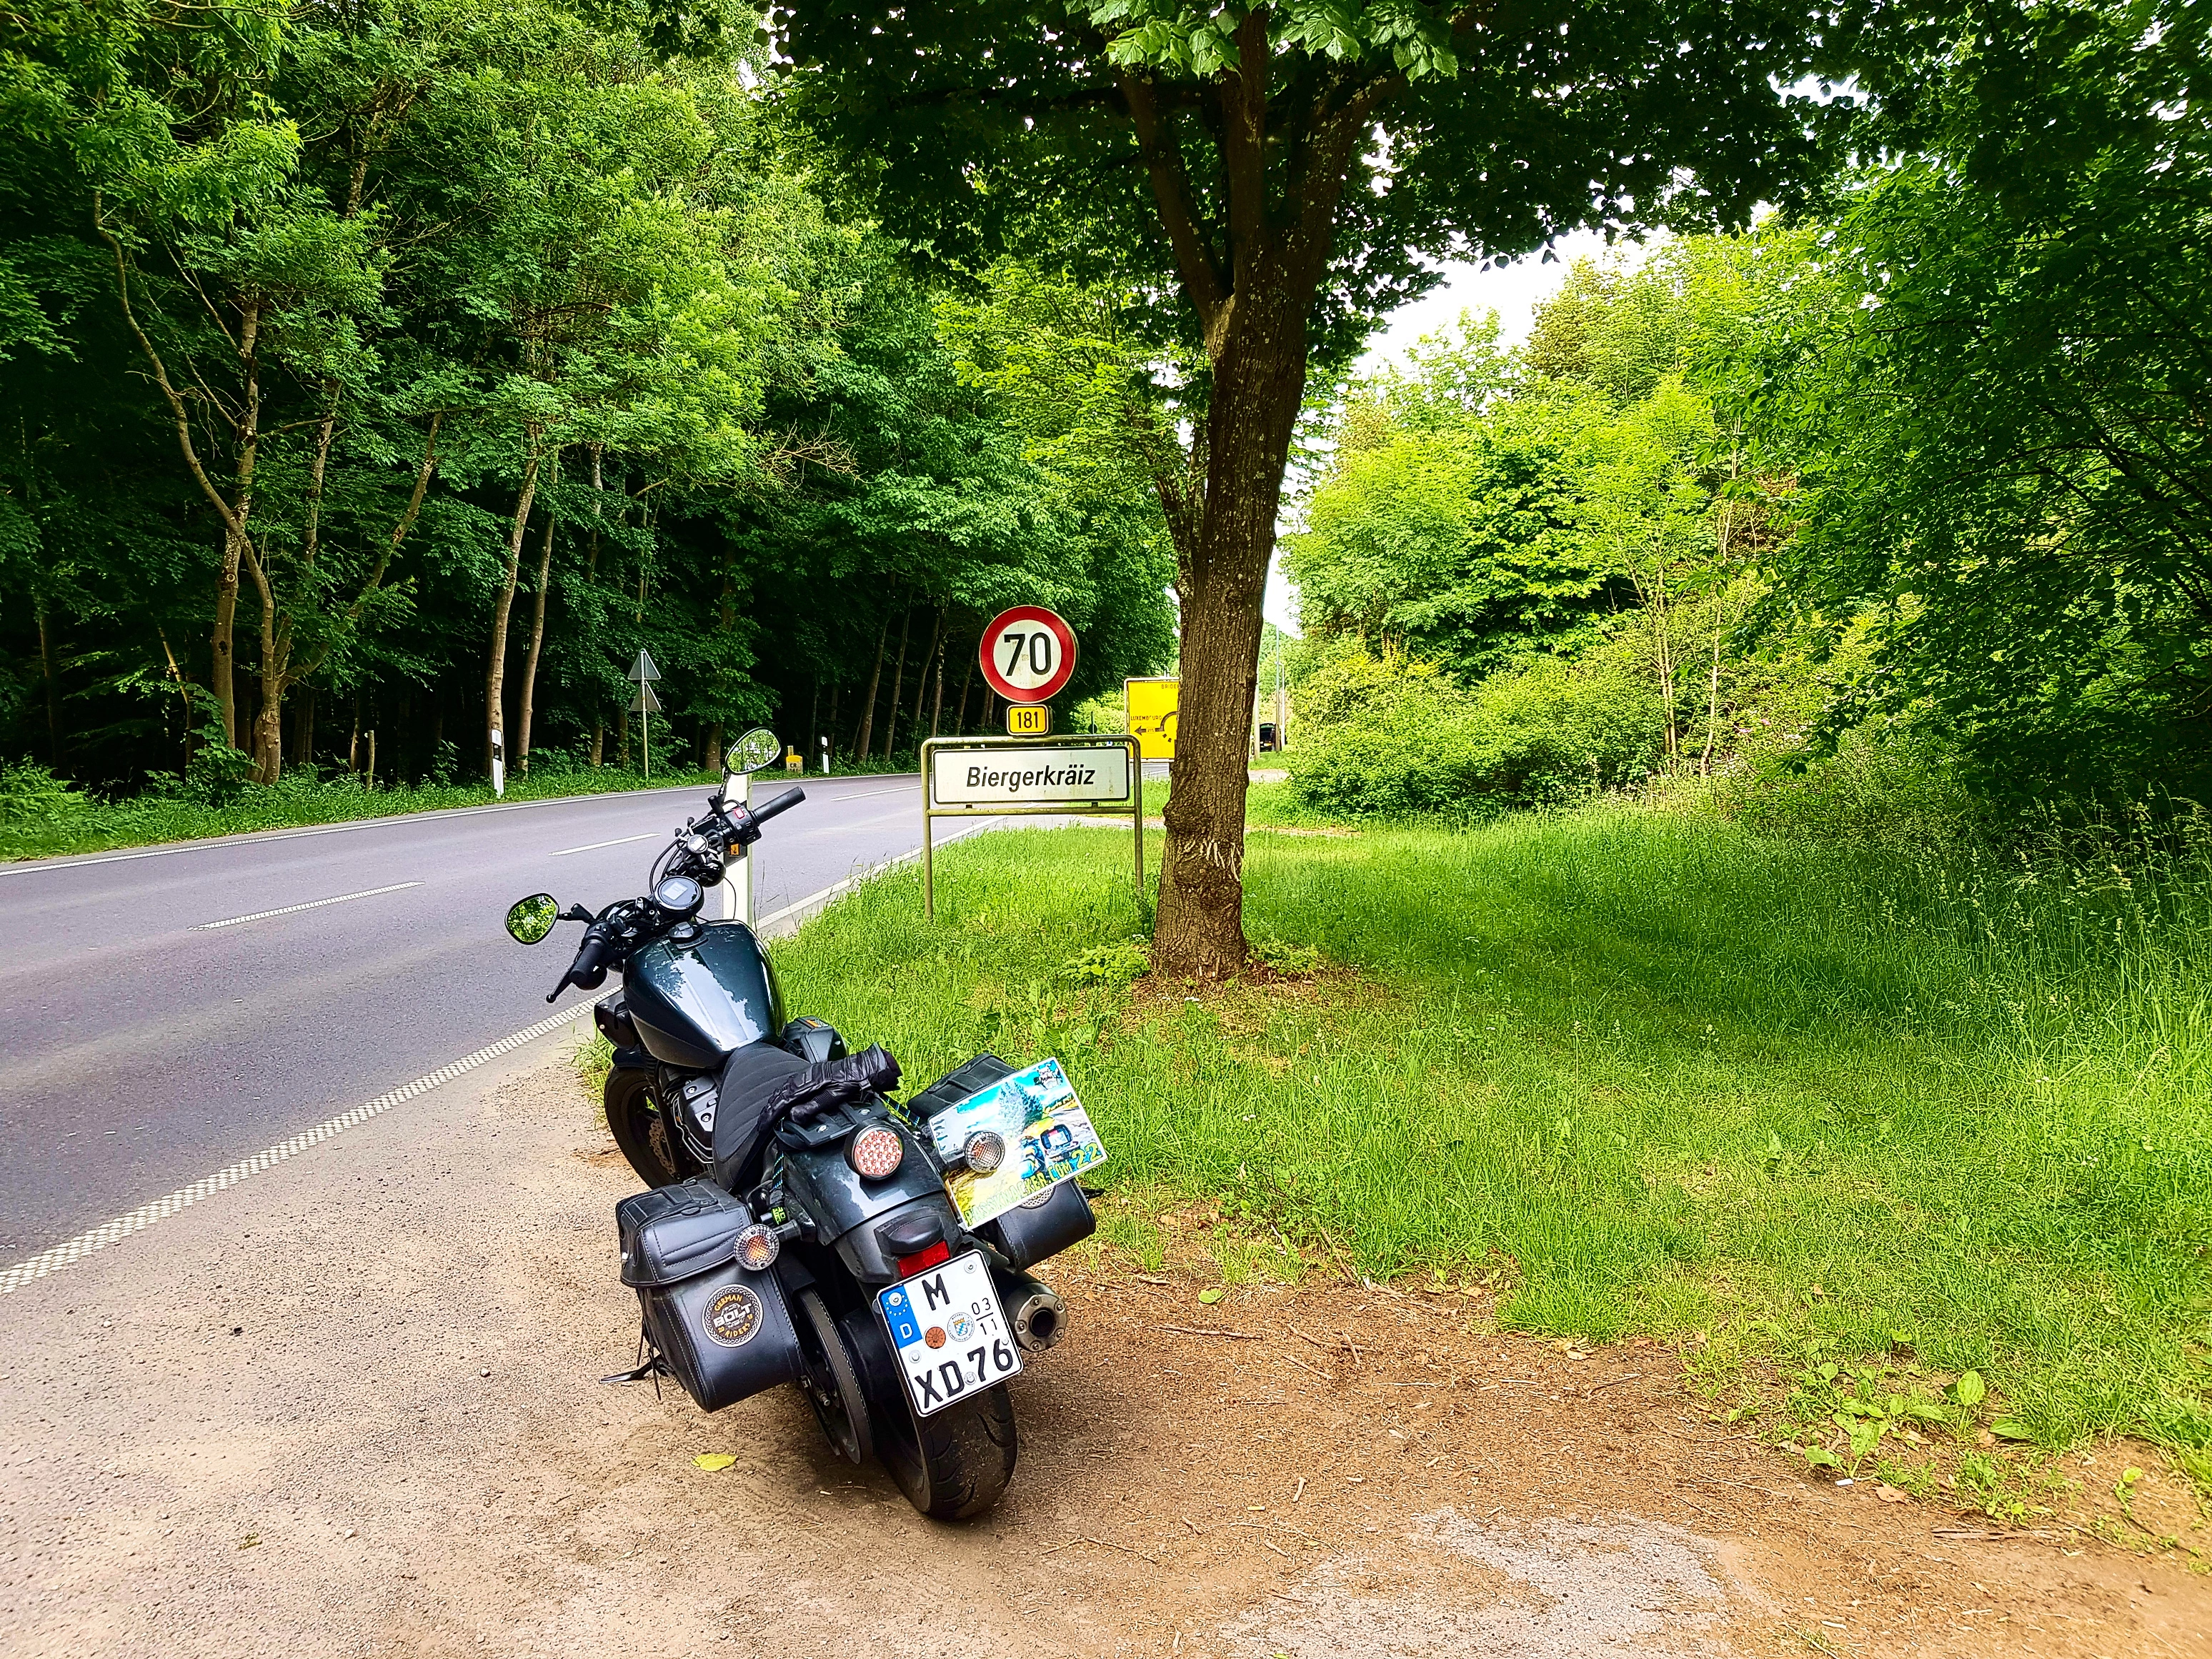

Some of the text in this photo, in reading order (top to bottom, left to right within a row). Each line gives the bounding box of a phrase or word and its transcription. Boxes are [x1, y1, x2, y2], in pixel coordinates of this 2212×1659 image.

[1004, 632, 1052, 676] 70
[1017, 712, 1038, 729] 181
[967, 764, 1095, 792] Biergerkräiz
[1072, 1142, 1102, 1170] 22
[921, 1273, 951, 1312] M
[714, 1294, 743, 1312] GERMAN
[971, 1297, 991, 1315] 03
[713, 1302, 752, 1328] BOLT
[724, 1322, 750, 1338] RIDERS
[899, 1322, 914, 1340] D
[980, 1318, 997, 1335] 11
